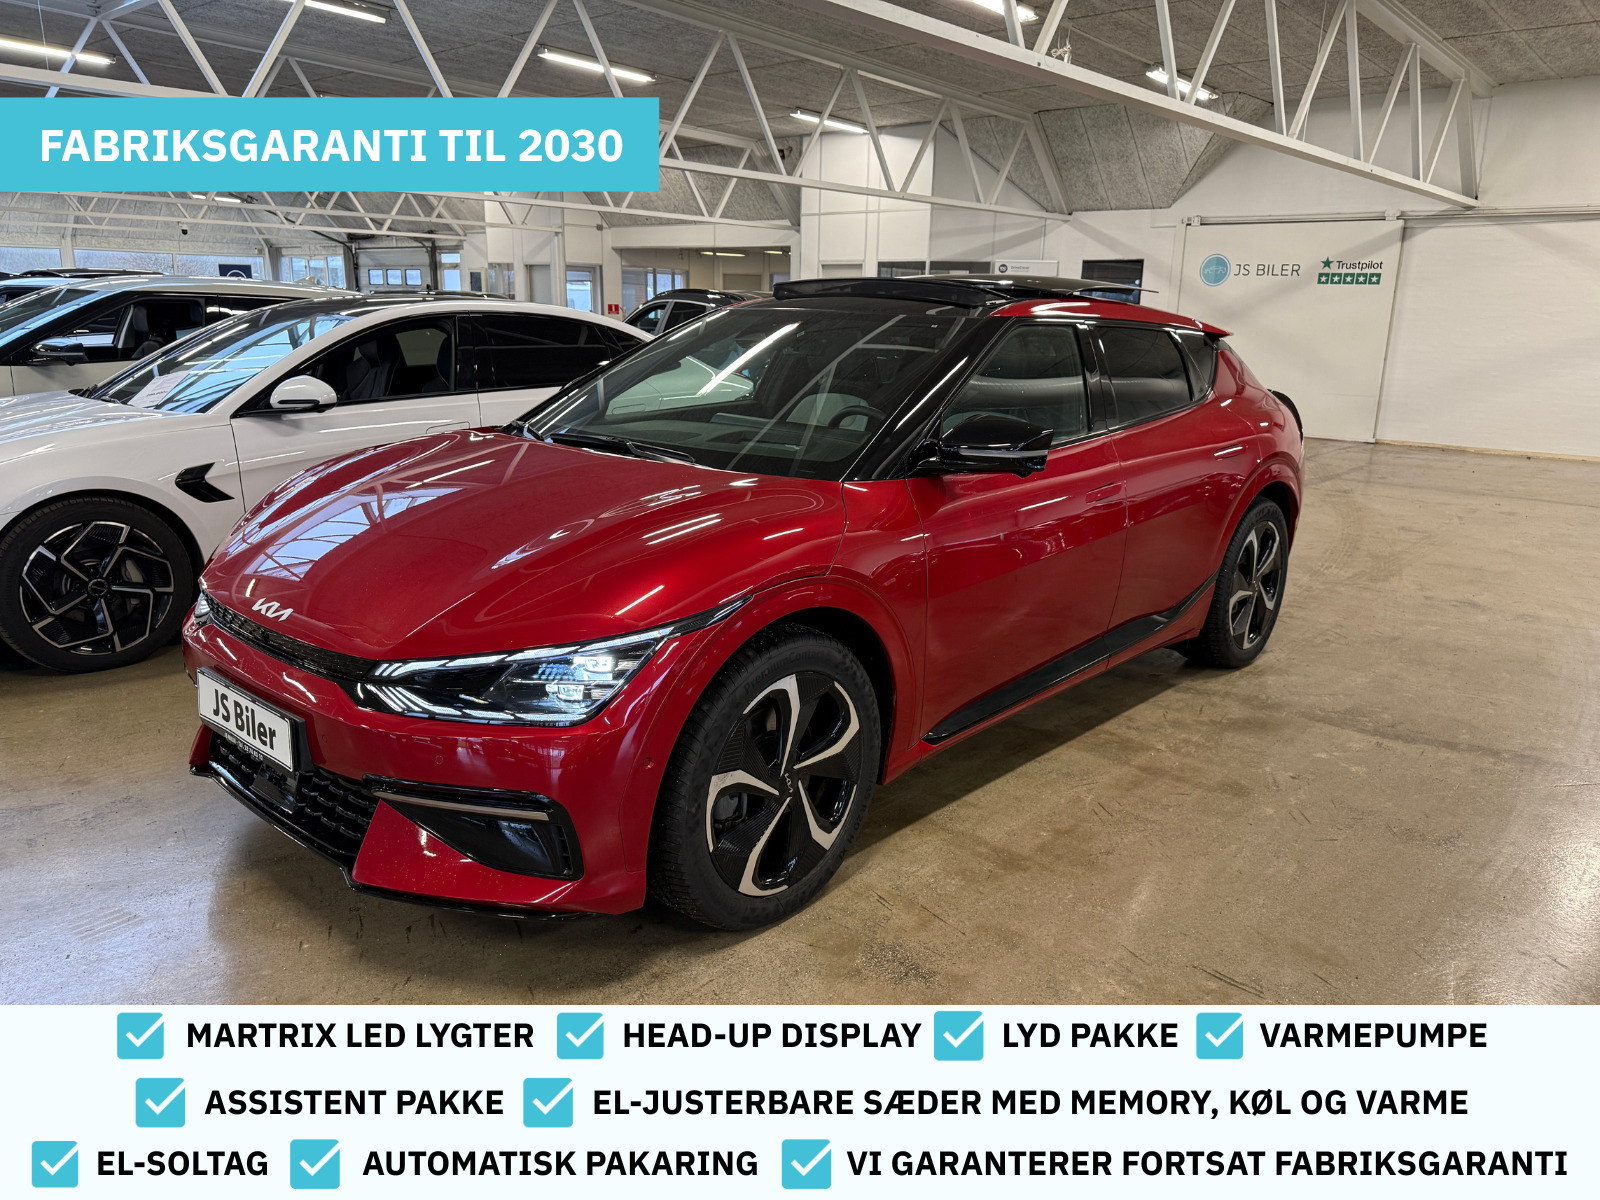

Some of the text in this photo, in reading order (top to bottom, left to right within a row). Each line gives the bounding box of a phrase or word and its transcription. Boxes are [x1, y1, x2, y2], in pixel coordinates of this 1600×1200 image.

[1234, 263, 1301, 277] JS BILER
[1336, 259, 1384, 272] Trustpilot
[251, 597, 294, 622] KIA
[213, 688, 231, 723] JS
[233, 699, 277, 751] Biler
